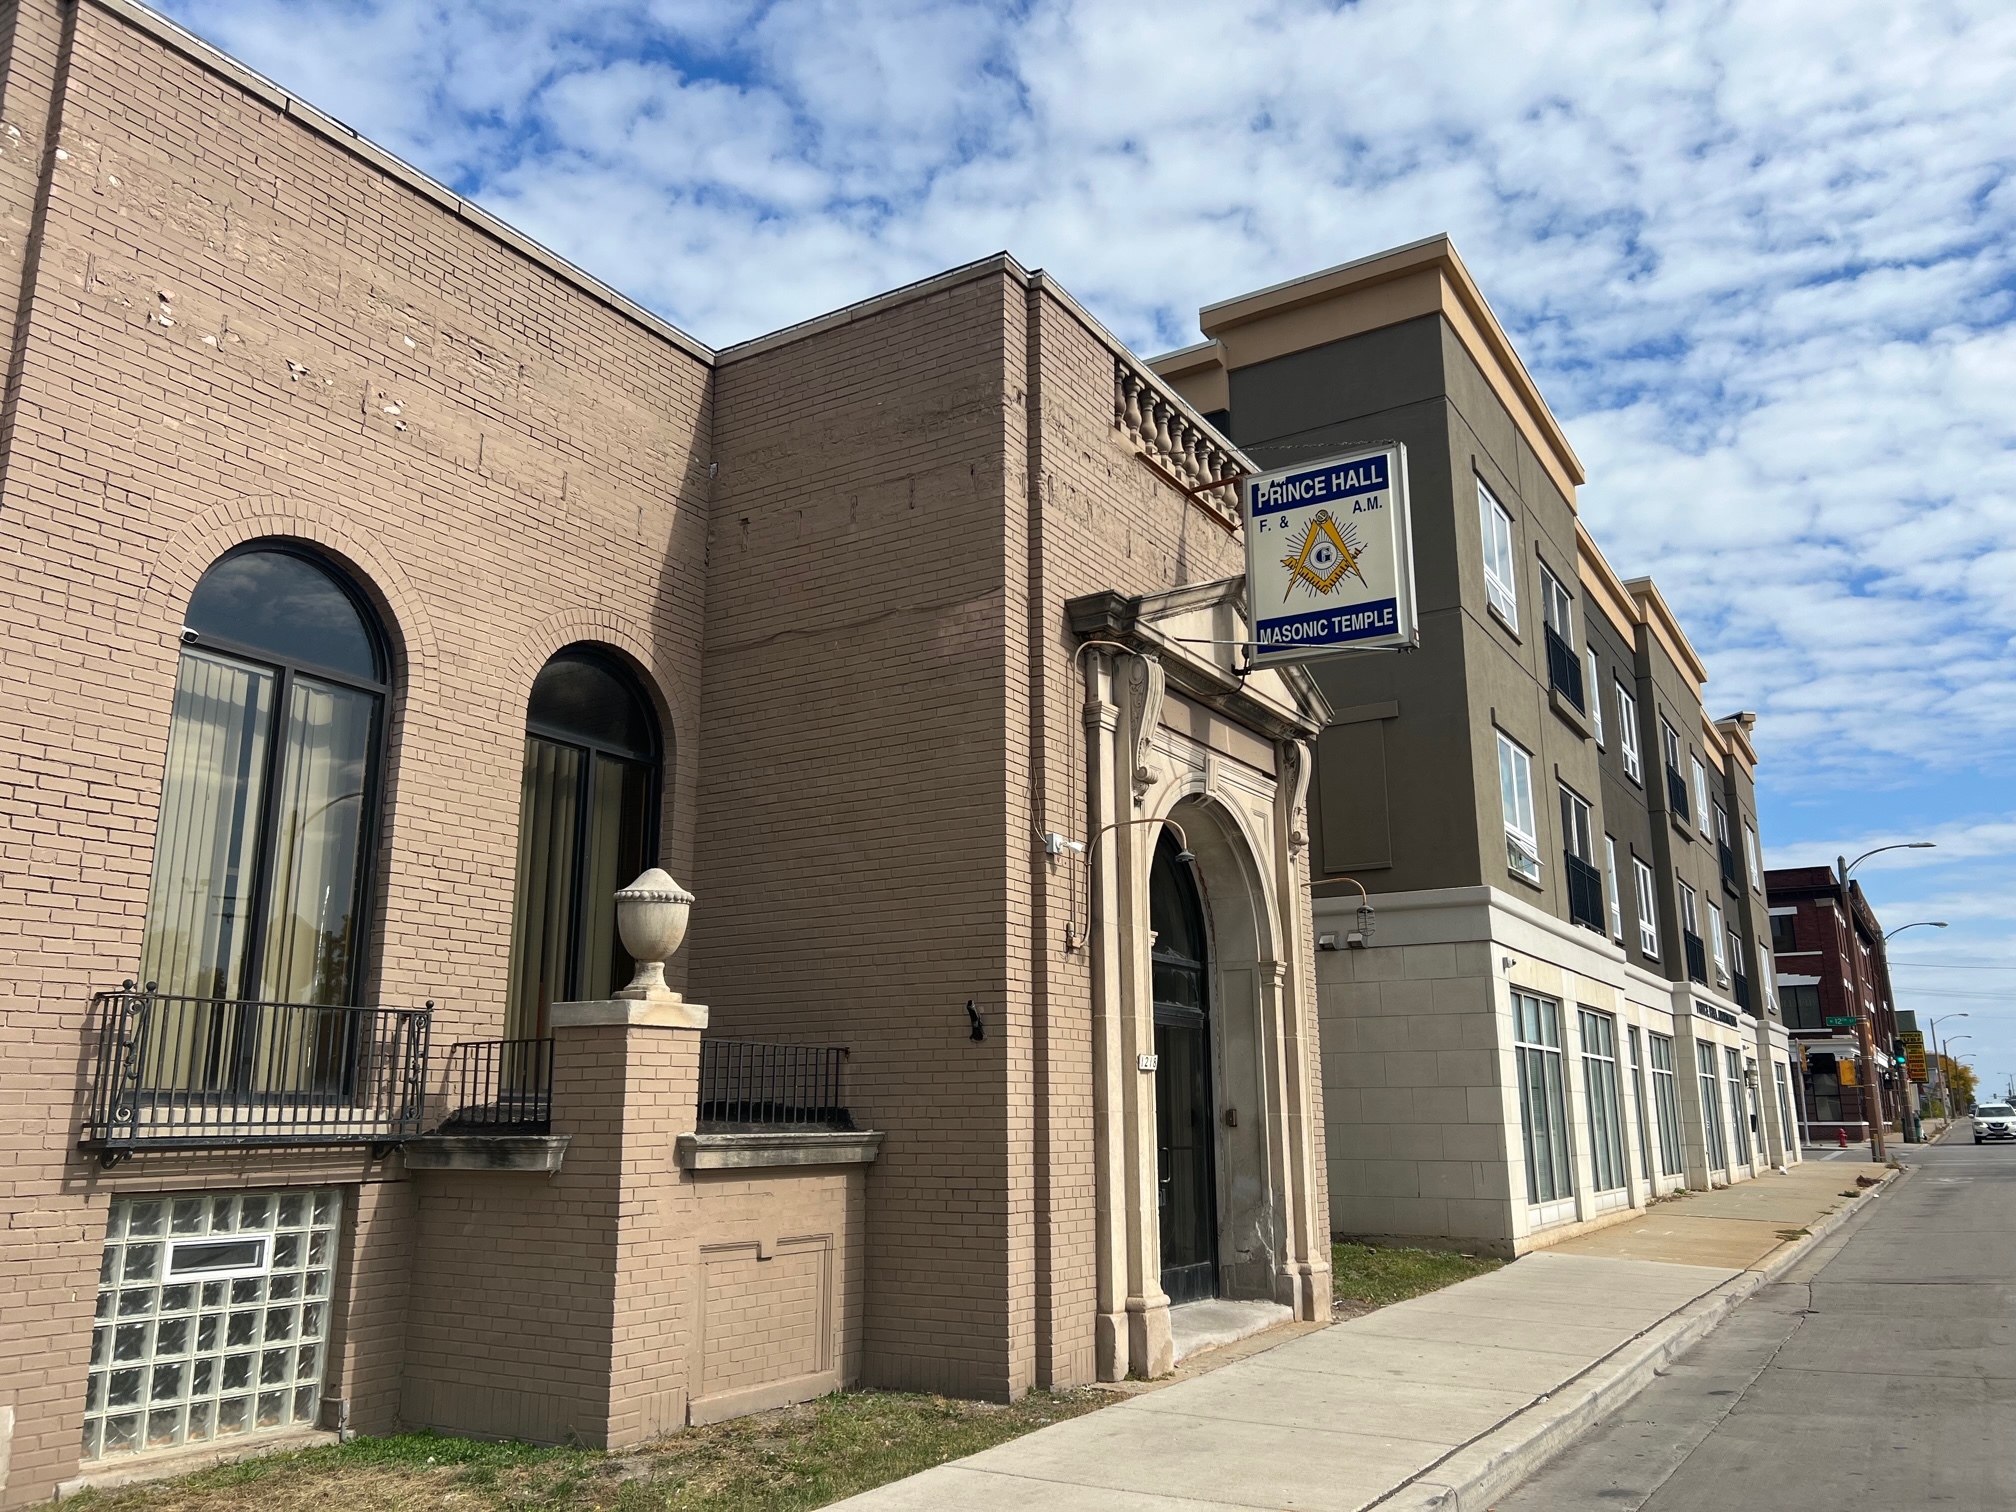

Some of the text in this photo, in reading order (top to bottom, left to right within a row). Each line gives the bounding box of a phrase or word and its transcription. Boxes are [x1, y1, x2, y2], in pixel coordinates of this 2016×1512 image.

[1258, 465, 1383, 508] PRINCE HALL
[1260, 496, 1383, 532] F. & A.M.
[1315, 546, 1333, 564] G
[1260, 608, 1393, 645] MASONIC TEMPLE
